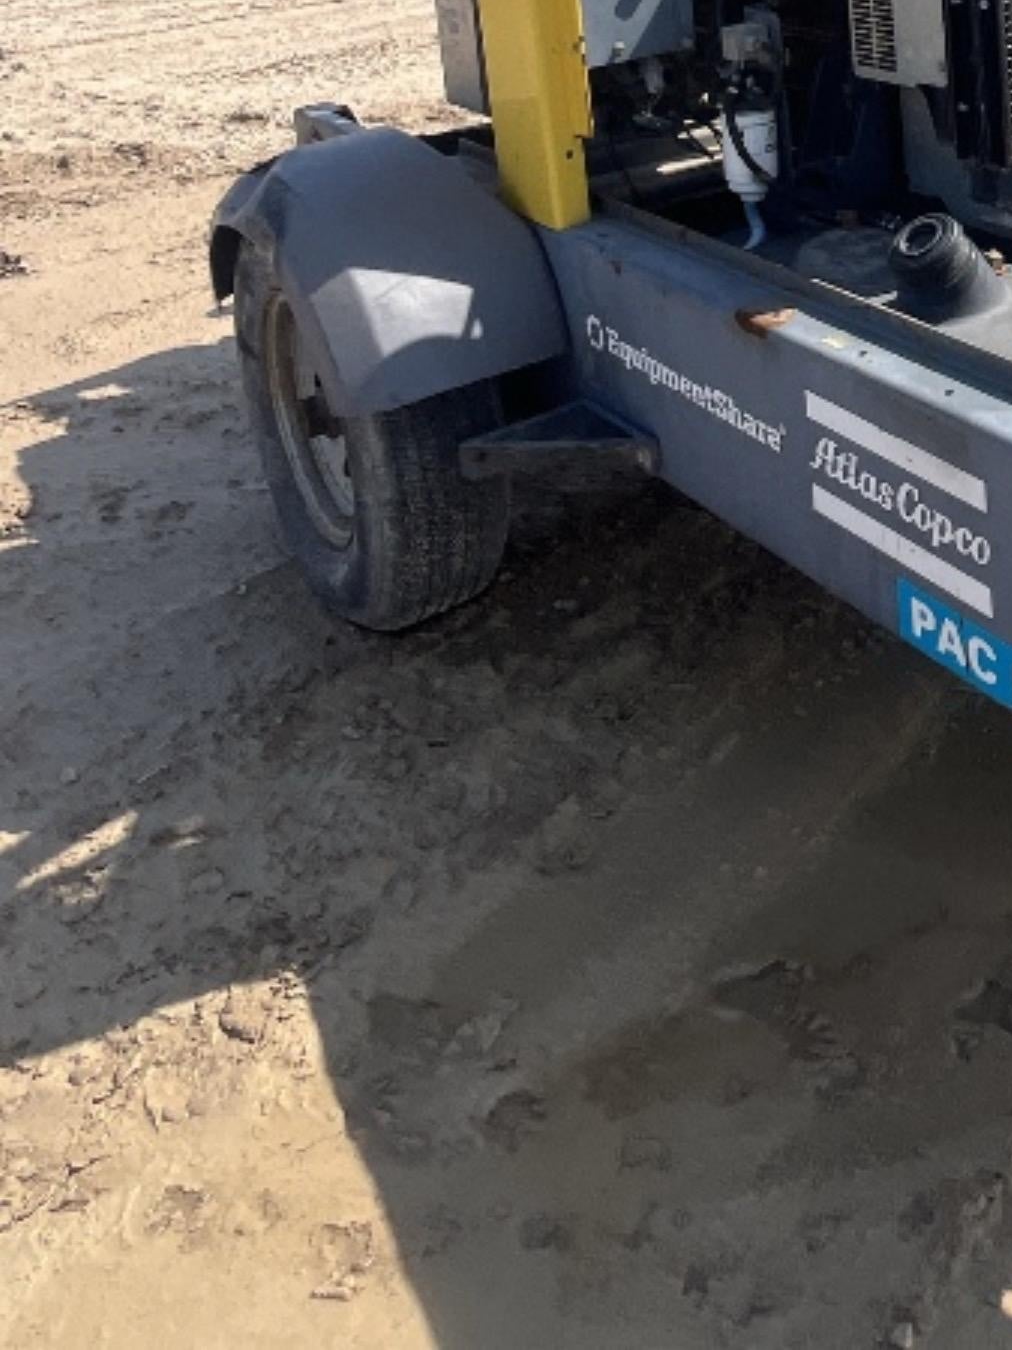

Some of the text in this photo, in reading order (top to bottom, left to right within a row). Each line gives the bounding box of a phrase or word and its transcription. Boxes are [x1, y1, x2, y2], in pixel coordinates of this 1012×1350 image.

[606, 326, 782, 453] EquipmentShare
[809, 436, 992, 565] Atlas Copco
[911, 596, 998, 685] PAC
